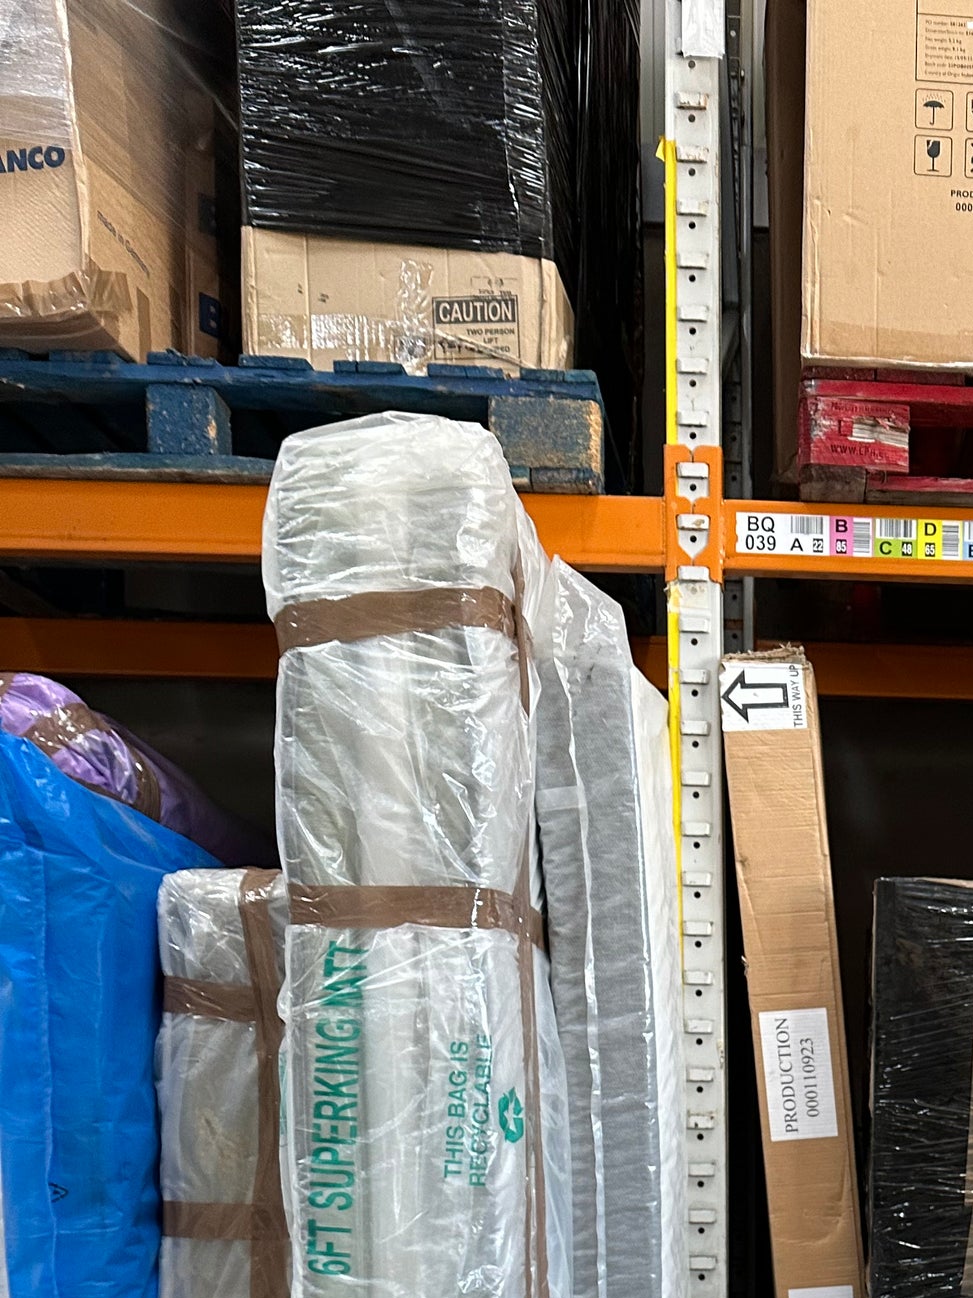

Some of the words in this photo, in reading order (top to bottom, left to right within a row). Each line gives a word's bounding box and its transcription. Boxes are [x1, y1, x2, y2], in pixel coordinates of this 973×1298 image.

[439, 301, 513, 322] CAUTION
[467, 328, 483, 336] TWO
[747, 515, 775, 533] BQ
[835, 518, 848, 533] B
[924, 522, 937, 536] D
[745, 534, 776, 551] 039
[790, 537, 803, 551] A
[813, 539, 823, 552] 22
[836, 540, 847, 553] 85
[879, 541, 892, 555] C
[902, 543, 912, 556] 48
[925, 543, 935, 556] 65
[789, 665, 800, 677] UP
[790, 680, 801, 701] WAY
[792, 704, 803, 727] THIS
[449, 1041, 469, 1062] IS
[775, 1018, 798, 1133] PRODUCTION
[800, 1038, 820, 1118] 000110923
[447, 1070, 468, 1118] BAG
[306, 1018, 362, 1211] SUPERKING
[469, 1033, 492, 1187] RECYCLABLE
[443, 1126, 465, 1178] THIS
[306, 1219, 352, 1276] 6FT
